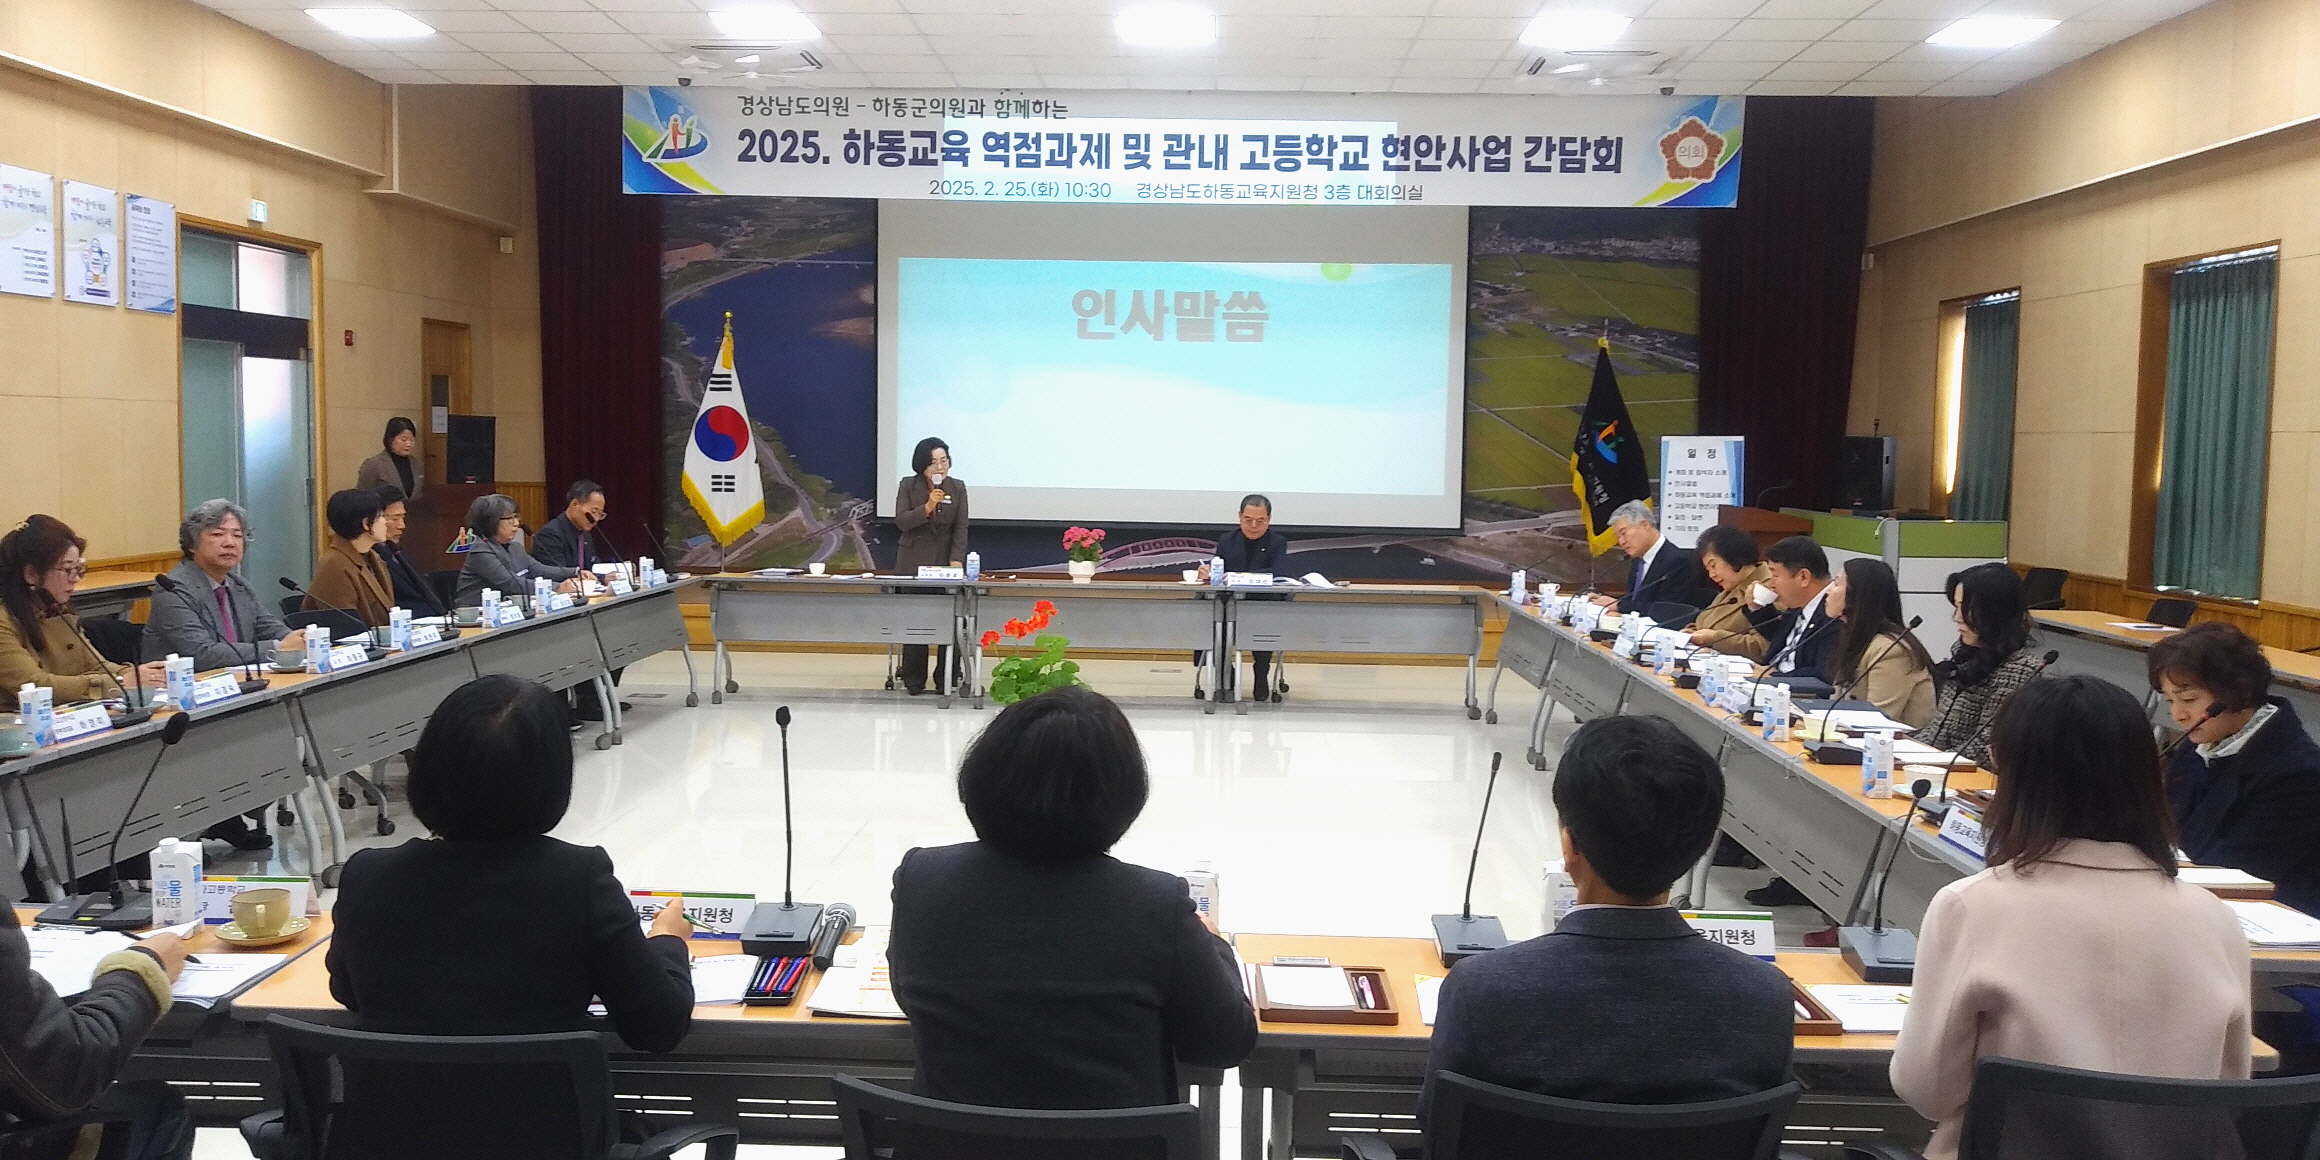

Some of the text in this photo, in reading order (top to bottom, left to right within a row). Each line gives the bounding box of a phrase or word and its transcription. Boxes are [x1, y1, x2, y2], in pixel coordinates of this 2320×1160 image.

[737, 95, 850, 118] 경상남도의원
[871, 96, 987, 119] 하동군의원과
[993, 98, 1069, 120] 함께하는
[737, 127, 1624, 174] 2025. 하동교육 역점과제 및 관내 고등학교 현안사업 간담회
[1678, 144, 1705, 160] 의회
[929, 179, 979, 196] 2025.
[1064, 182, 1112, 198] 10:30
[1136, 182, 1318, 200] 경상남도하동교육지원청
[1323, 184, 1352, 201] 3층
[1357, 184, 1423, 201] 대회의실
[1071, 287, 1270, 343] 인사말씀
